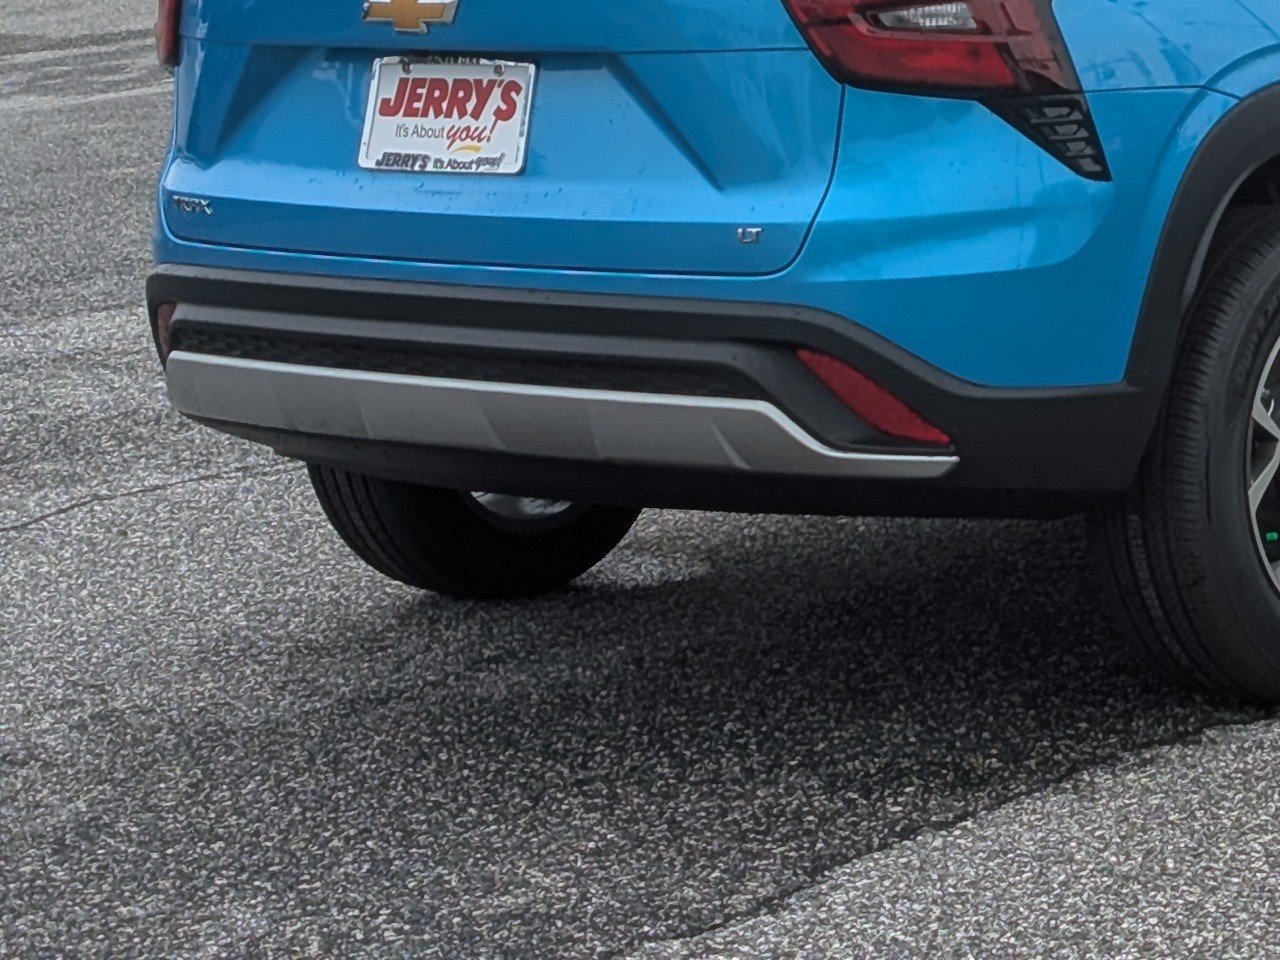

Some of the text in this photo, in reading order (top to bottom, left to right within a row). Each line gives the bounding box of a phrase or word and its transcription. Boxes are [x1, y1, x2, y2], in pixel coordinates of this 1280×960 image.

[378, 77, 523, 122] JERRY'S
[395, 117, 496, 151] It's About you!
[375, 151, 431, 170] JERRY'S
[445, 158, 473, 171] About
[737, 227, 763, 244] LT
